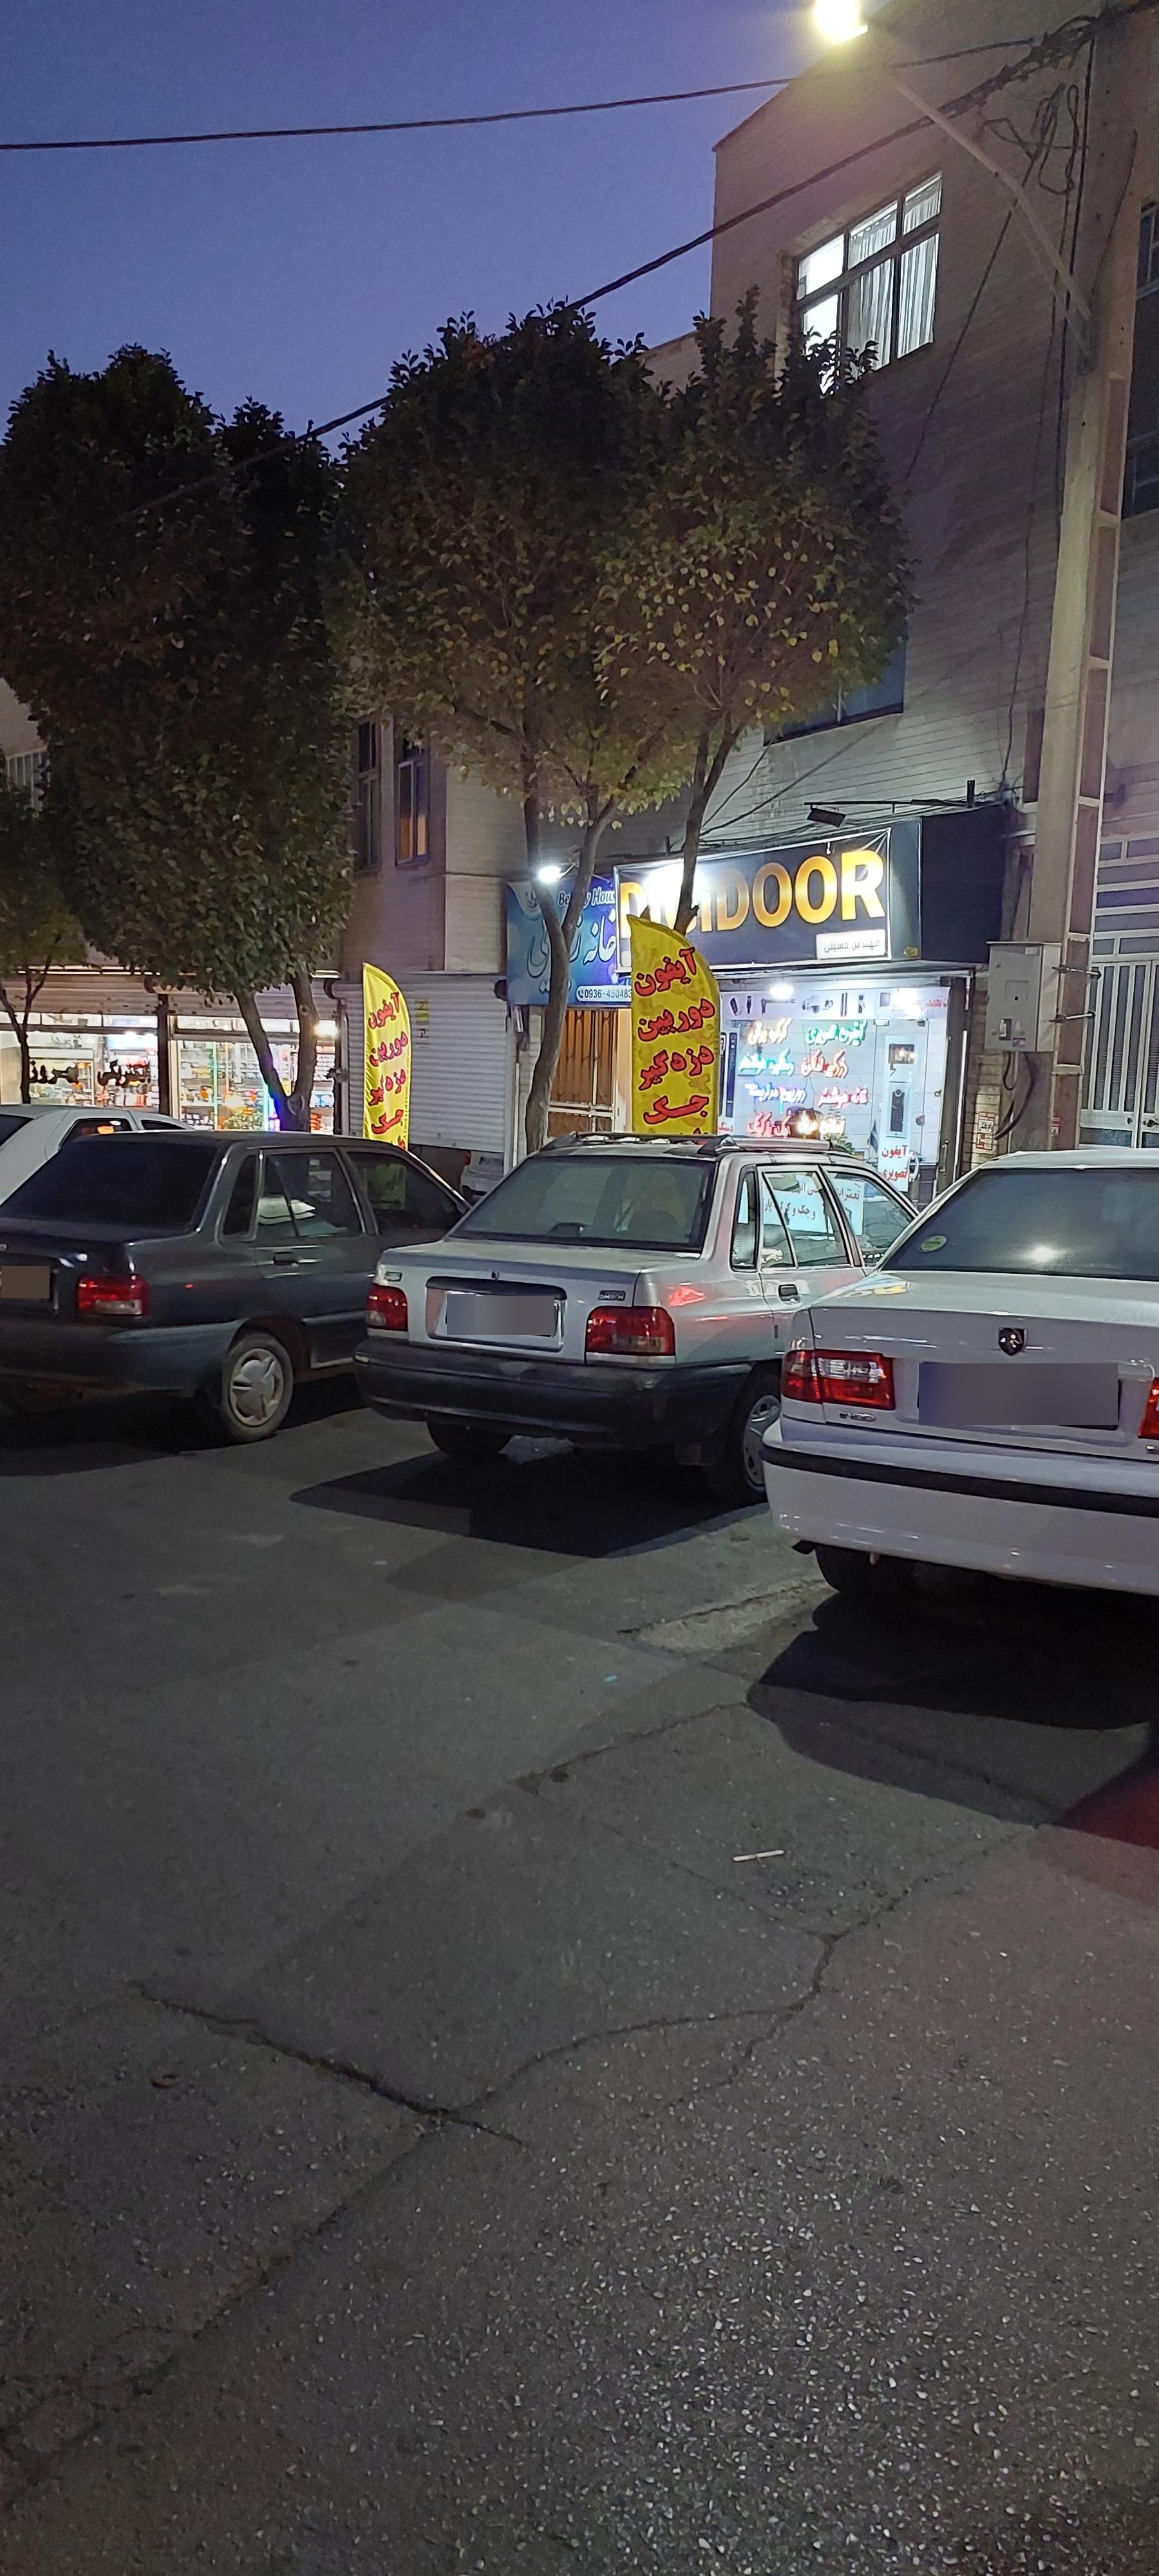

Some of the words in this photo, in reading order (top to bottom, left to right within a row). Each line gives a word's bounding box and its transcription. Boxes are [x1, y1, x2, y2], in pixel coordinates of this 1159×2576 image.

[592, 886, 616, 905] Hous
[851, 940, 880, 951] مهندس
[634, 947, 695, 996] آیفون
[584, 989, 632, 998] 0936-450483
[368, 992, 400, 1030] آیفون
[637, 998, 715, 1041] دوربین
[643, 1095, 709, 1124] جک
[882, 1144, 908, 1159] آیفون
